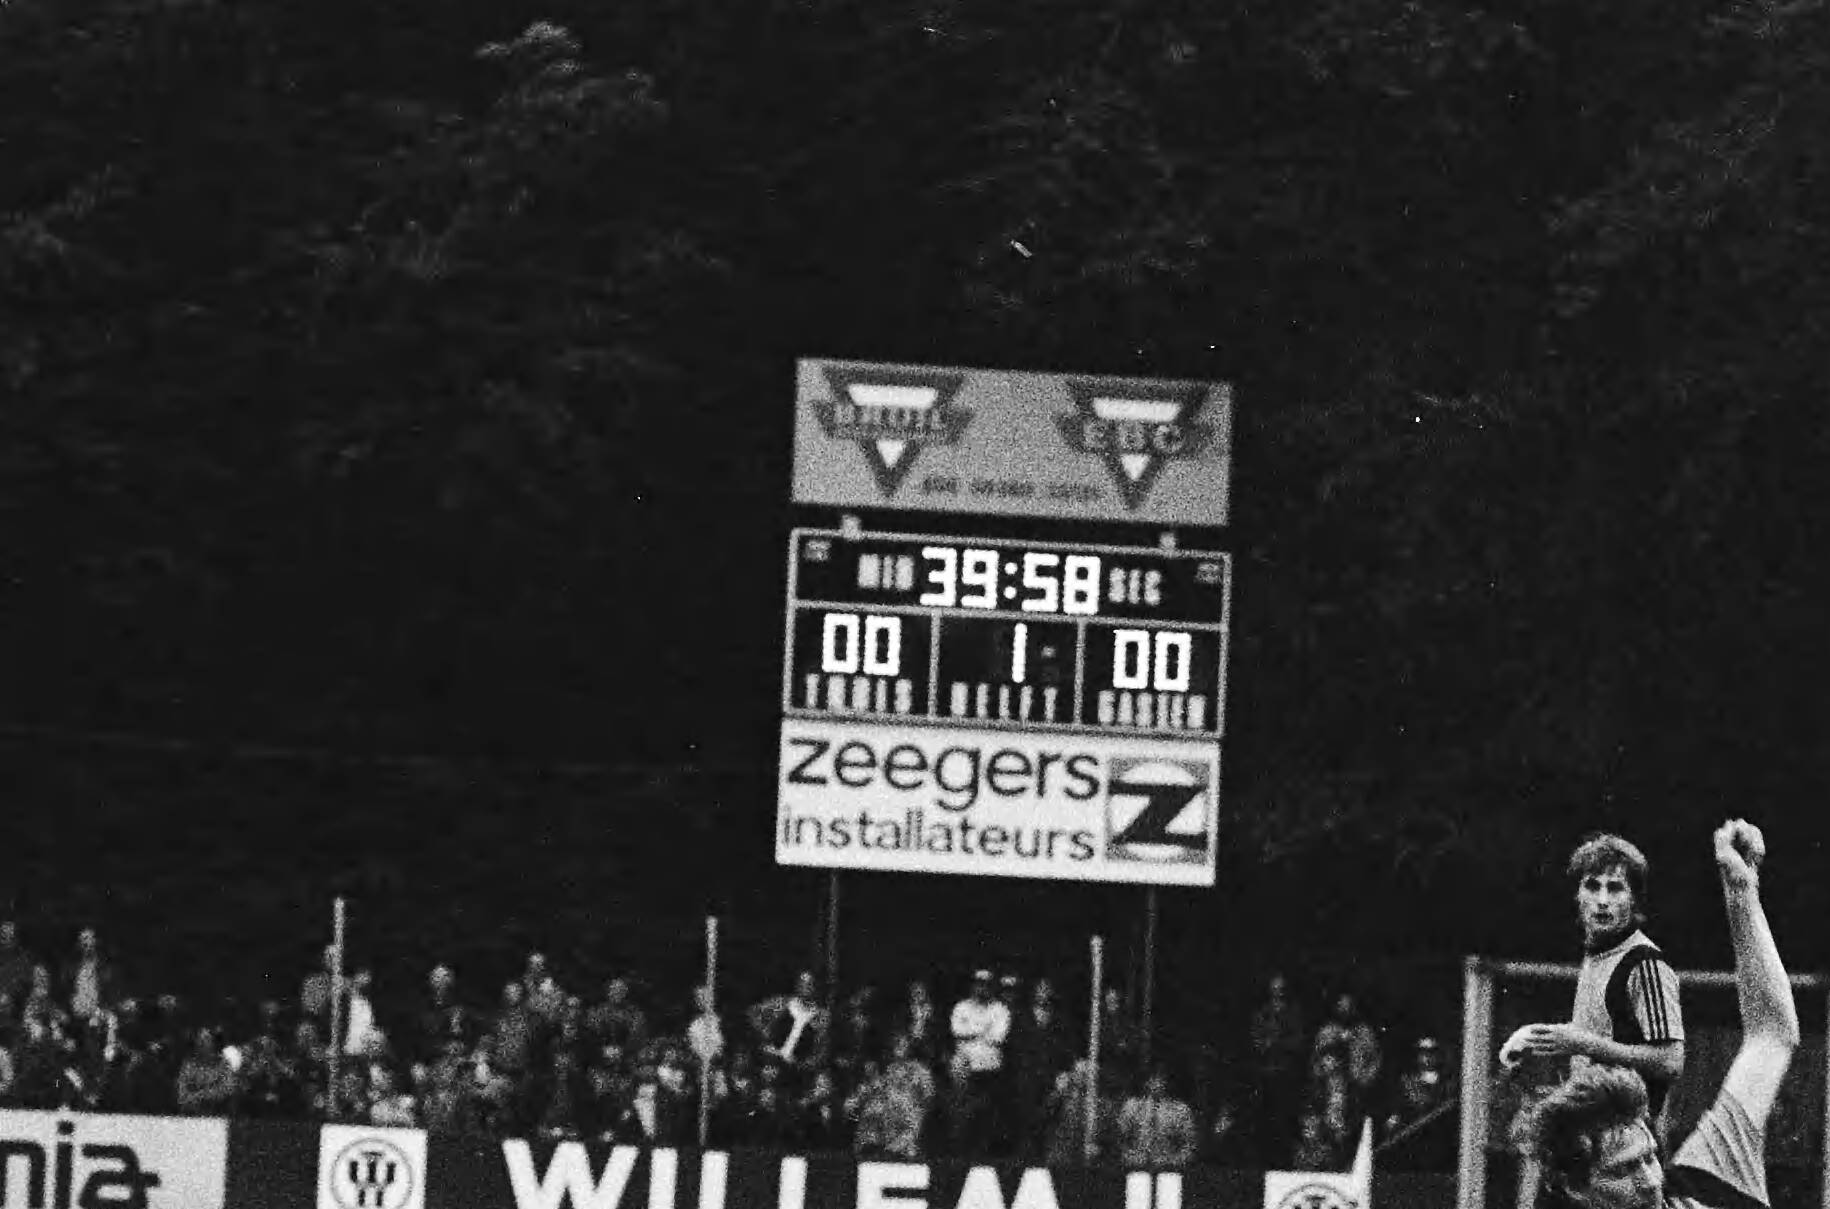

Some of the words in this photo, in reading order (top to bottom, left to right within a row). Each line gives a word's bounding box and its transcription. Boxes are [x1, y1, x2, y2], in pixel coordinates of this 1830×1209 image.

[919, 547, 1101, 616] 39:58
[821, 613, 901, 676] 00
[1011, 622, 1028, 683] 1
[1112, 629, 1192, 692] 00
[788, 737, 1100, 811] zeegers
[783, 805, 1096, 861] installateurs
